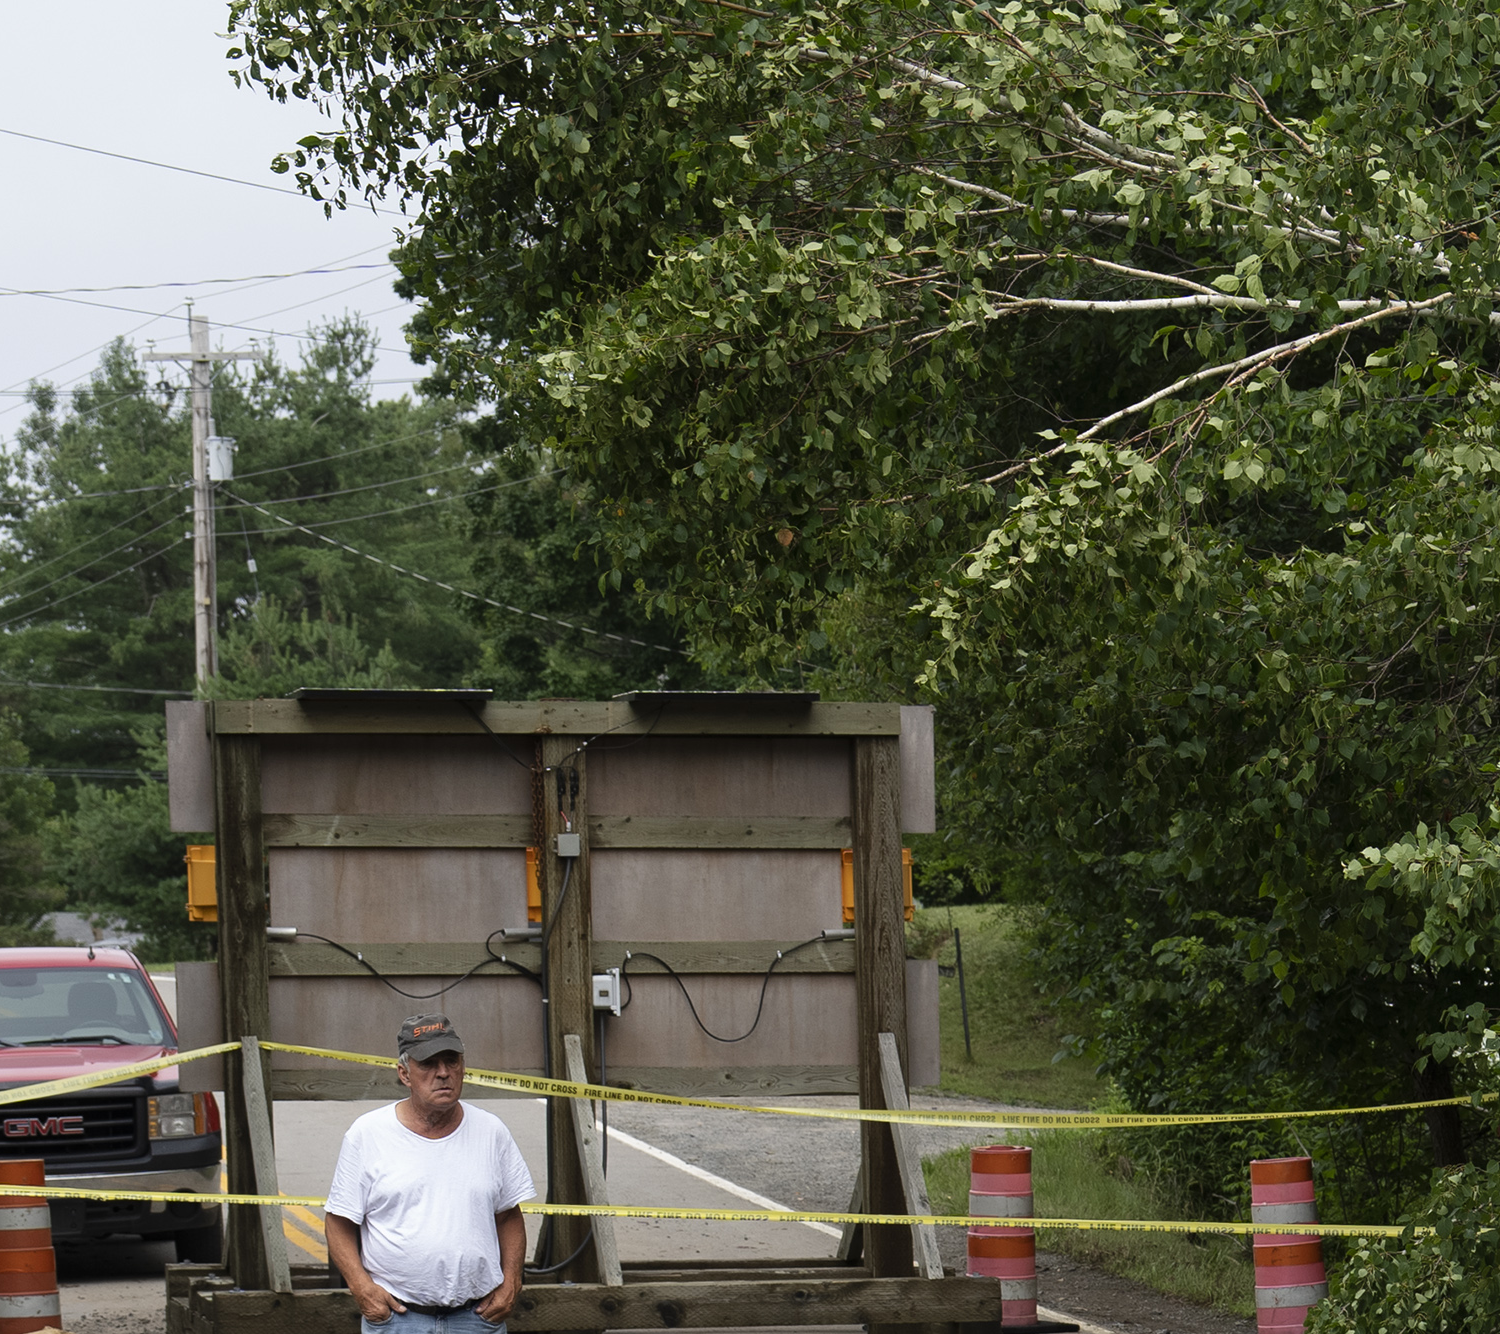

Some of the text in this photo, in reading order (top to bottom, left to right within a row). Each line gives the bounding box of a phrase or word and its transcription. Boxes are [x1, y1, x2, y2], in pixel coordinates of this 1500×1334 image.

[414, 1023, 446, 1038] STIHL
[480, 1074, 498, 1084] FIRE
[499, 1076, 518, 1086] LINE
[519, 1079, 531, 1089] DO
[533, 1081, 549, 1091] NOT
[550, 1083, 578, 1095] CROSS
[584, 1088, 602, 1097] FIRE
[604, 1091, 622, 1101] LINE
[624, 1093, 635, 1101] DO
[637, 1095, 653, 1103] NOT
[4, 1116, 84, 1136] GMC
